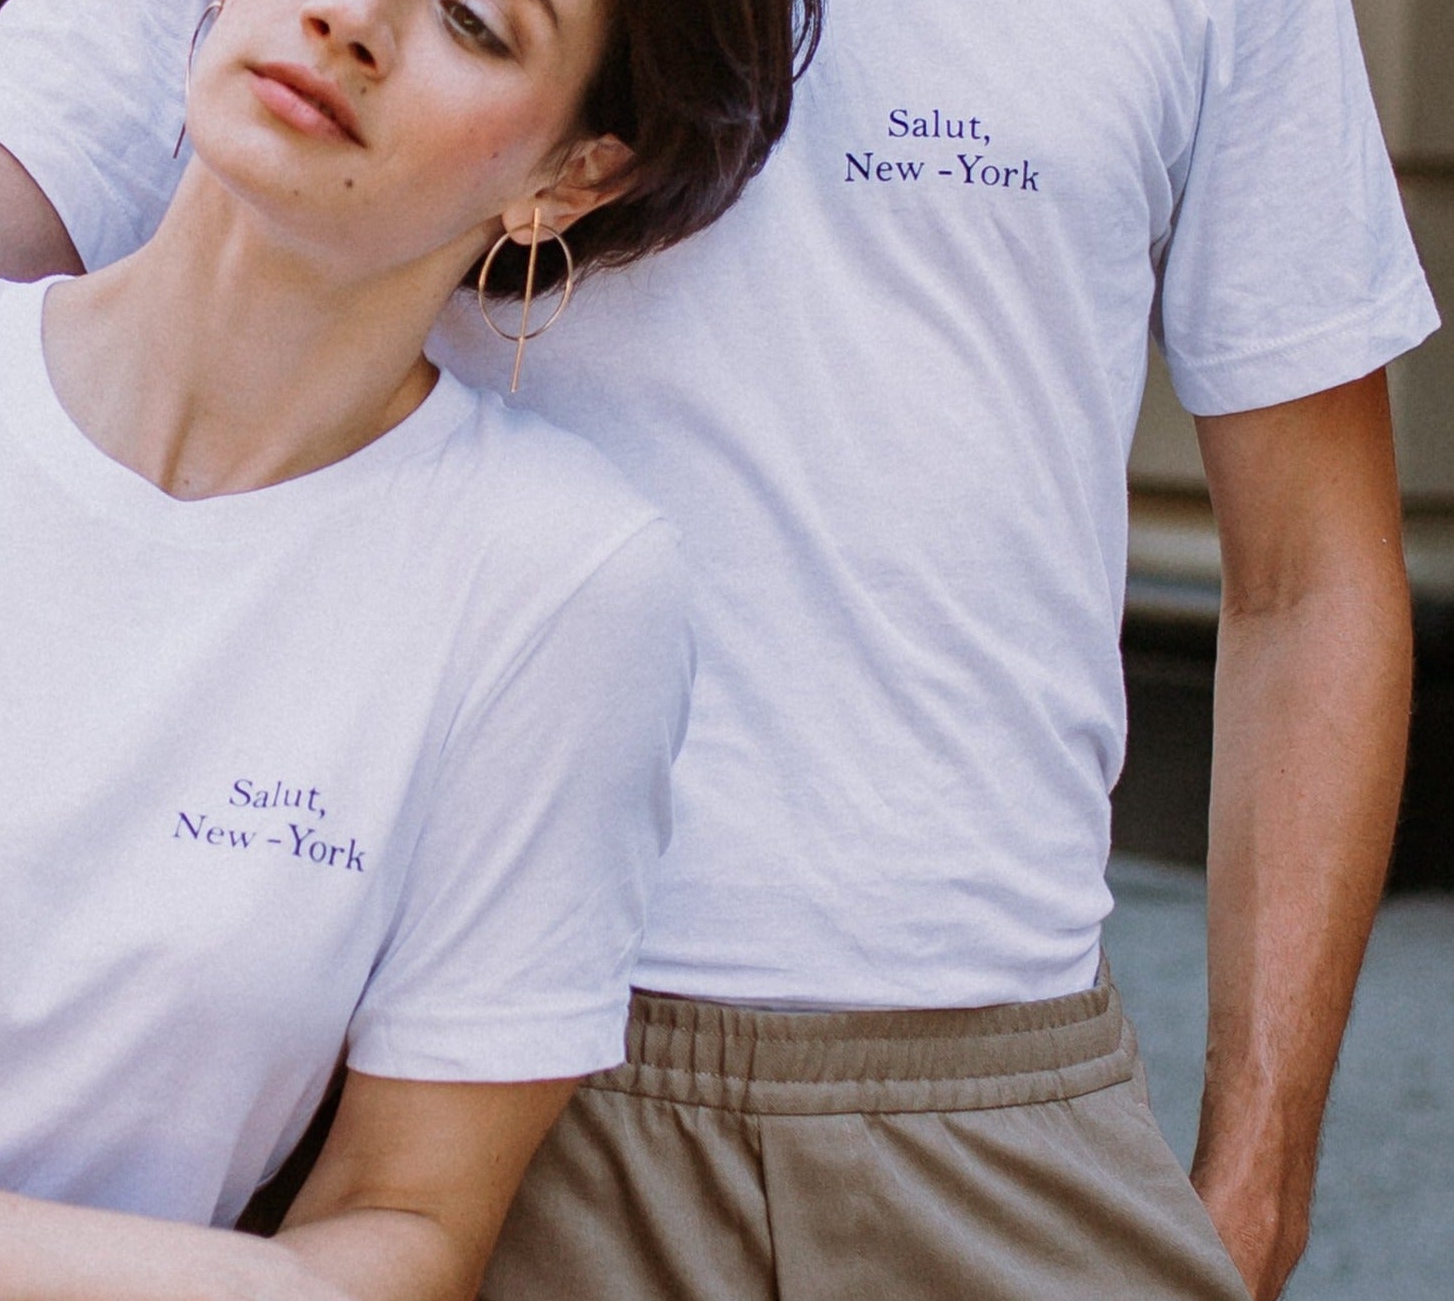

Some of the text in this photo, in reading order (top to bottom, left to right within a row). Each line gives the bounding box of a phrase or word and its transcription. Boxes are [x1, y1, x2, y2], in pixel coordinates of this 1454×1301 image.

[887, 108, 991, 147] Salut,
[844, 152, 925, 183] New
[228, 778, 326, 819] Salut,
[172, 811, 258, 849] New
